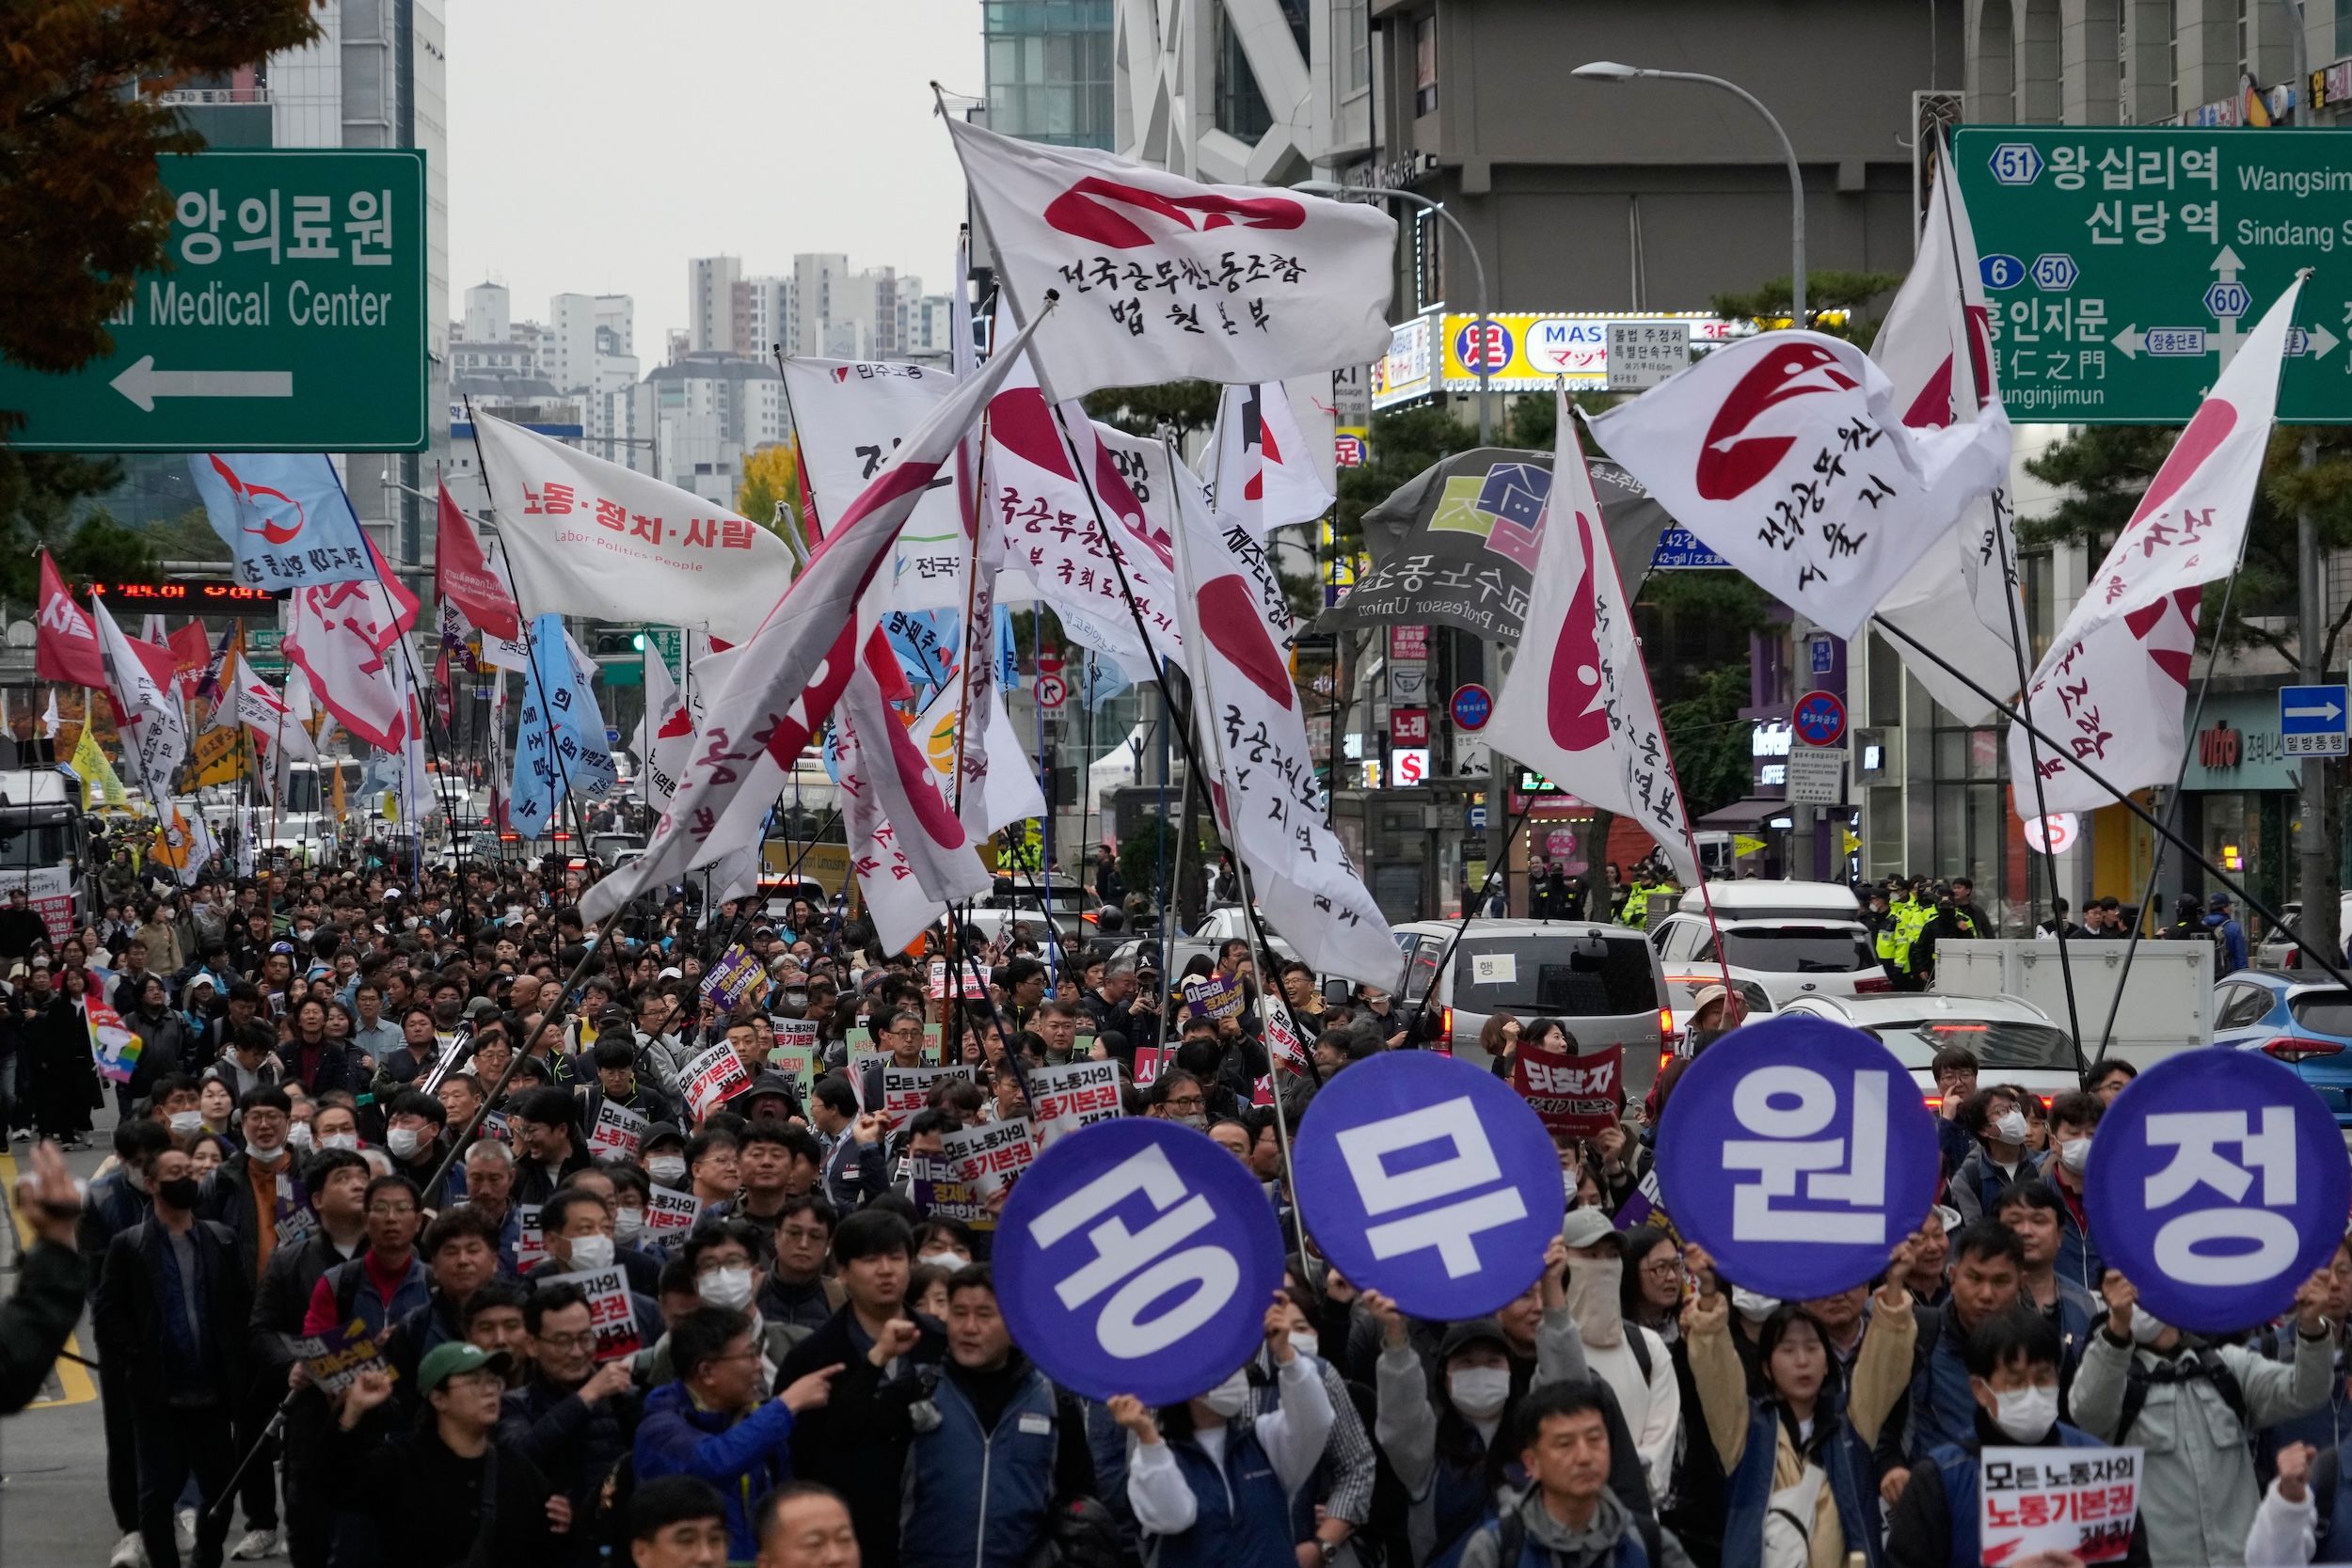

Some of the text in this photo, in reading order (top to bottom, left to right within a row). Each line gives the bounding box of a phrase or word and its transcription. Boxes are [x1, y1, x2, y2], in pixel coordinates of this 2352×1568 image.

[2002, 150, 2028, 178] 51
[2048, 145, 2218, 190] 왕십리역
[176, 187, 393, 266] 앙의료원
[2085, 199, 2218, 245] 신당역
[2237, 218, 2334, 251] Sindang
[1991, 259, 2067, 283] 6 50
[150, 280, 271, 326] Medical
[288, 278, 392, 326] Center
[2214, 289, 2239, 312] 60
[1546, 325, 1607, 343] MAS
[1613, 328, 1638, 343] 불법
[2153, 332, 2199, 351] 장충단로
[1613, 345, 1683, 360] 특별단속구역
[856, 363, 924, 380] 민주노총
[1335, 387, 1363, 398] assage
[2000, 385, 2105, 410] unginjimun
[1656, 531, 1698, 550] 42길
[1395, 715, 1425, 738] 노래
[1800, 711, 1839, 726] 주정차금지
[2286, 736, 2343, 752] 일방통행
[700, 962, 730, 995] 미국의
[1184, 979, 1224, 1004] 미국의
[772, 1033, 815, 1046] 동기본권
[786, 1022, 817, 1034] 노동자의
[1267, 1020, 1306, 1058] 노동기본
[677, 1043, 731, 1094] 모든 노동자의
[686, 1054, 740, 1108] 노동기본권
[1052, 1065, 1113, 1093] 노동자의
[1523, 1057, 1615, 1096] 되찾자
[885, 1073, 914, 1092] 모든
[598, 1105, 622, 1126] 모든
[594, 1124, 640, 1152] 노동기본
[944, 1123, 1026, 1163] 모든 노동자의
[1721, 1064, 1889, 1245] 원
[933, 1181, 969, 1204] 경제
[1335, 1095, 1529, 1280] 무
[2144, 1105, 2300, 1287] 정
[1028, 1142, 1241, 1360] 공
[1985, 1455, 2135, 1493] 모든 노동자의
[1986, 1482, 2136, 1529] 노동기본권
